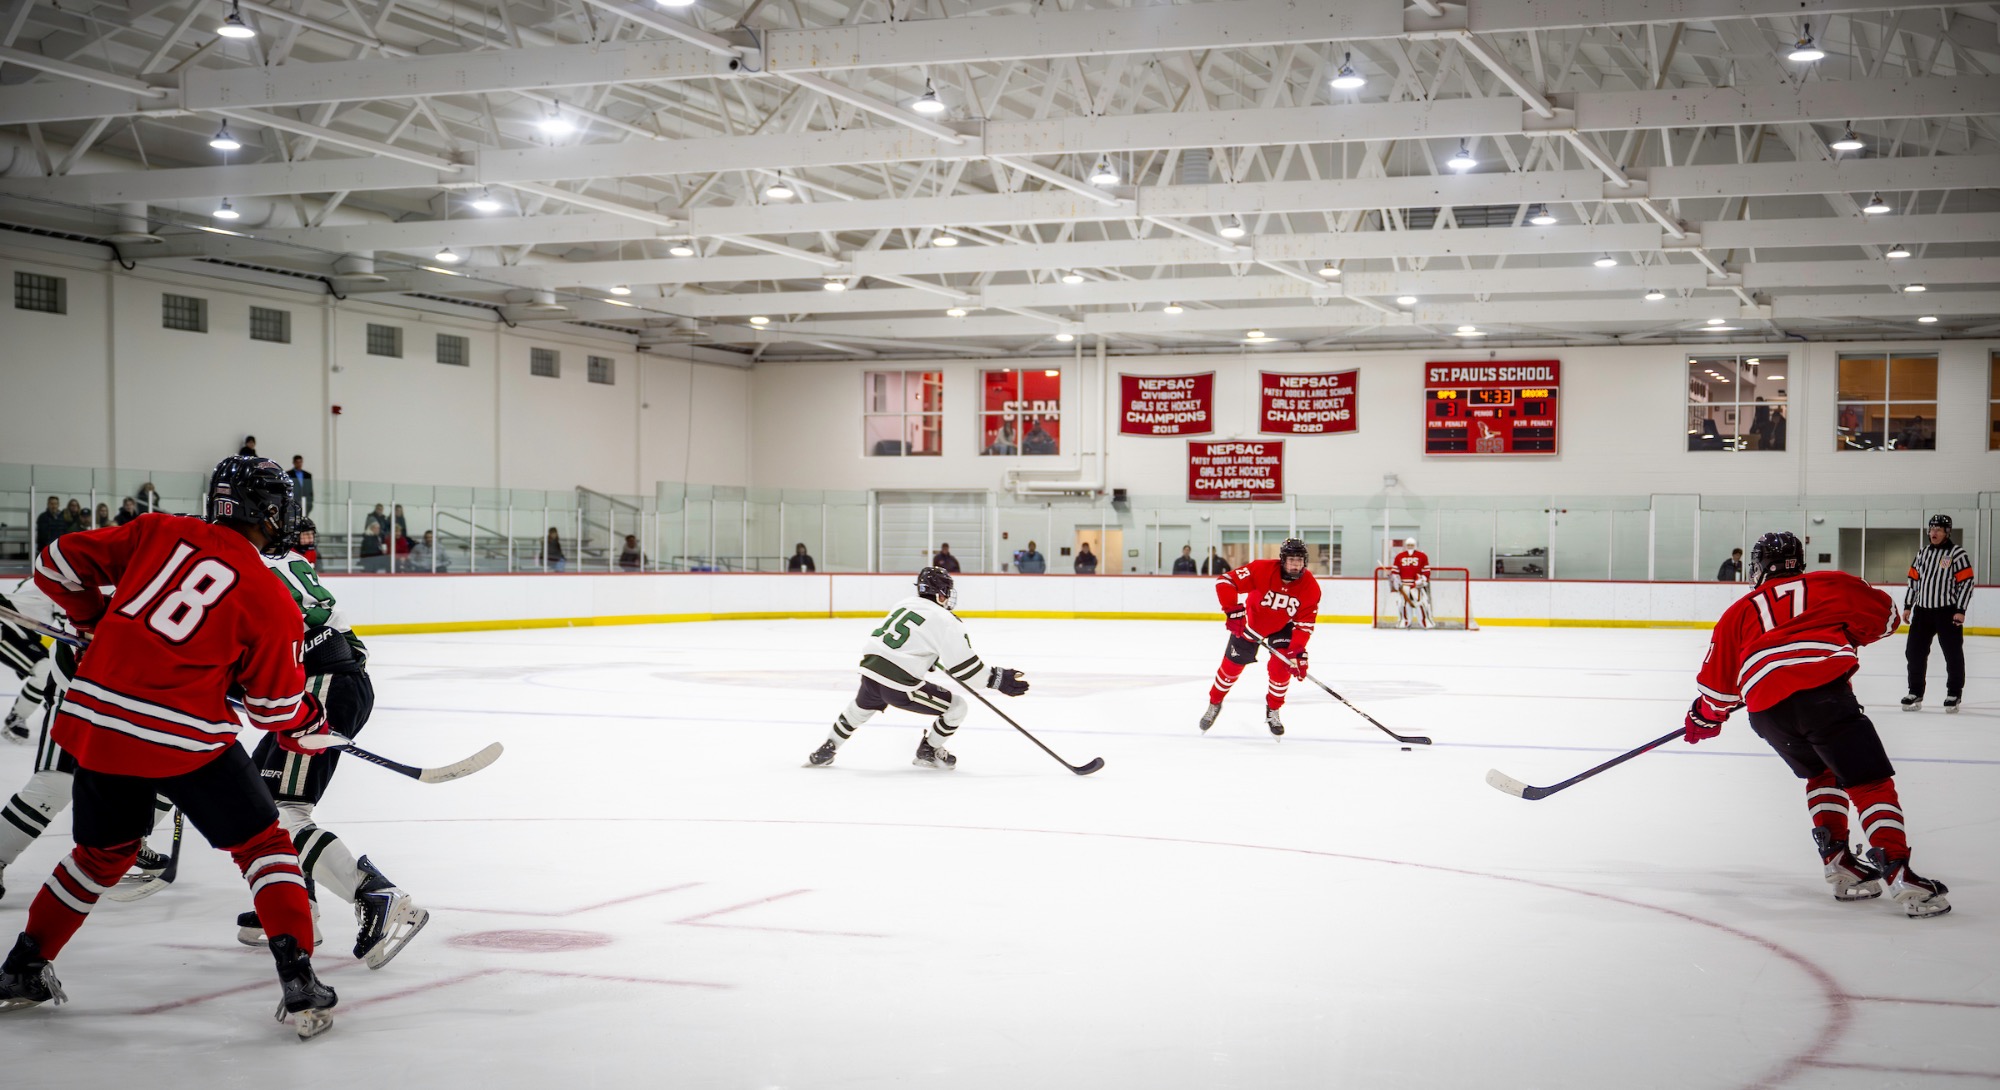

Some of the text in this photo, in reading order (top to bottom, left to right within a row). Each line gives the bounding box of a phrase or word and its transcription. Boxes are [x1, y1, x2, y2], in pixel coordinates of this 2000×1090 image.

[1430, 366, 1554, 382] ST. PAUL'S SCHOOL
[1139, 378, 1195, 389] NEPSAC
[1280, 376, 1338, 387] NEPSAC
[1141, 391, 1192, 399] DIVISION I
[1264, 388, 1283, 396] PATSY
[1307, 389, 1328, 397] LARGE
[1329, 387, 1353, 396] SCHOOL
[1480, 390, 1511, 403] 4:33
[1131, 400, 1201, 411] GIRLS ICE HOCKEY
[1272, 398, 1345, 410] GIRLS ICE HOCKEY
[1448, 402, 1455, 416] 3
[1126, 411, 1206, 423] CHAMPIONS
[1267, 409, 1350, 422] CHAMPIONS
[1292, 424, 1323, 432] 2020
[1207, 444, 1264, 455] NEPSAC
[1233, 456, 1254, 464] LARGE
[1255, 456, 1280, 464] SCHOOL
[1200, 466, 1270, 477] GIRLS ICE HOCKEY
[1195, 478, 1275, 489] CHAMPIONS
[1220, 490, 1250, 498] 2023
[218, 501, 233, 515] 18
[1401, 557, 1419, 566] SPS
[1785, 559, 1797, 569] 17
[1235, 567, 1251, 580] 23
[115, 539, 239, 645] 18
[1260, 590, 1300, 617] SPS
[1751, 579, 1807, 633] 17
[871, 607, 926, 650] 15
[260, 769, 283, 778] UER
